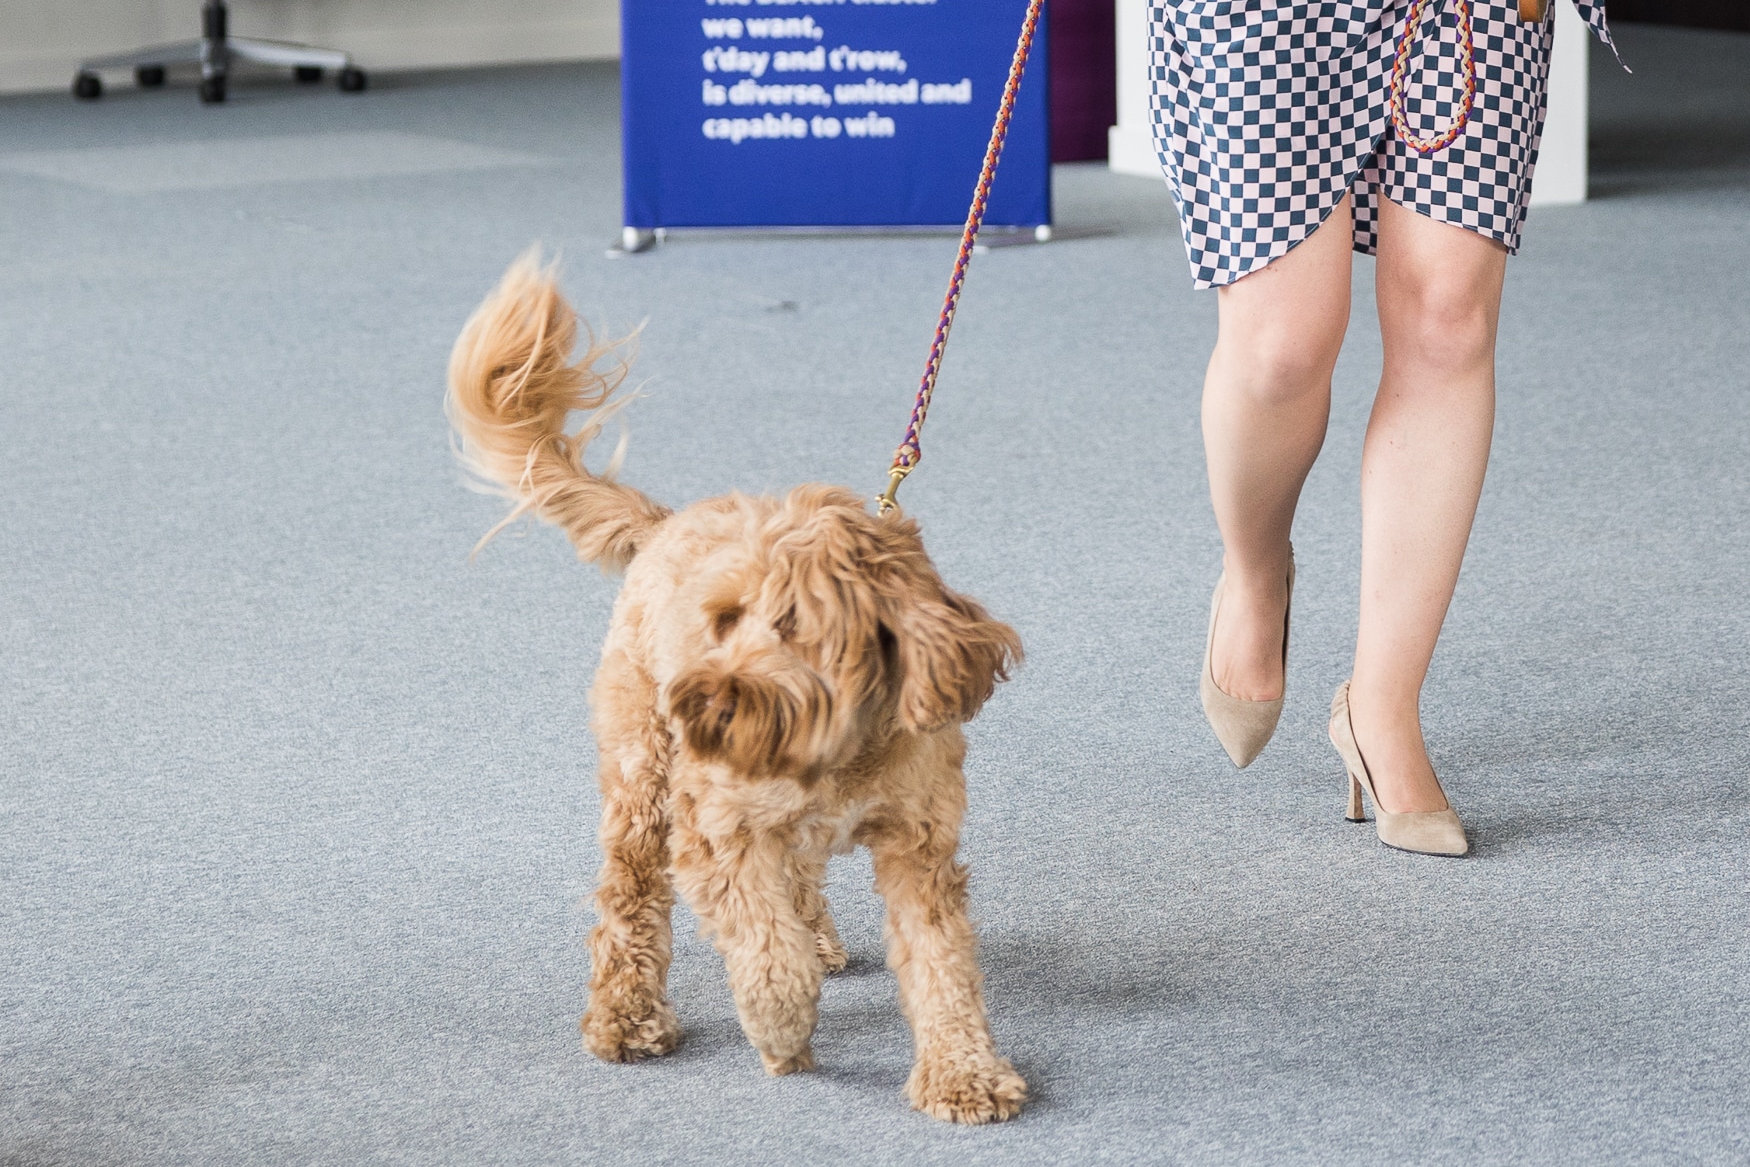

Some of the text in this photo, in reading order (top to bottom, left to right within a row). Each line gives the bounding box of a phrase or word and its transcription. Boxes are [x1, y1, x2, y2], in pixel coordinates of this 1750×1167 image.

[701, 15, 824, 41] we want,
[773, 45, 826, 72] and
[728, 79, 832, 108] diverse,
[834, 77, 919, 104] united
[920, 78, 972, 104] and
[702, 111, 896, 144] capable to win
